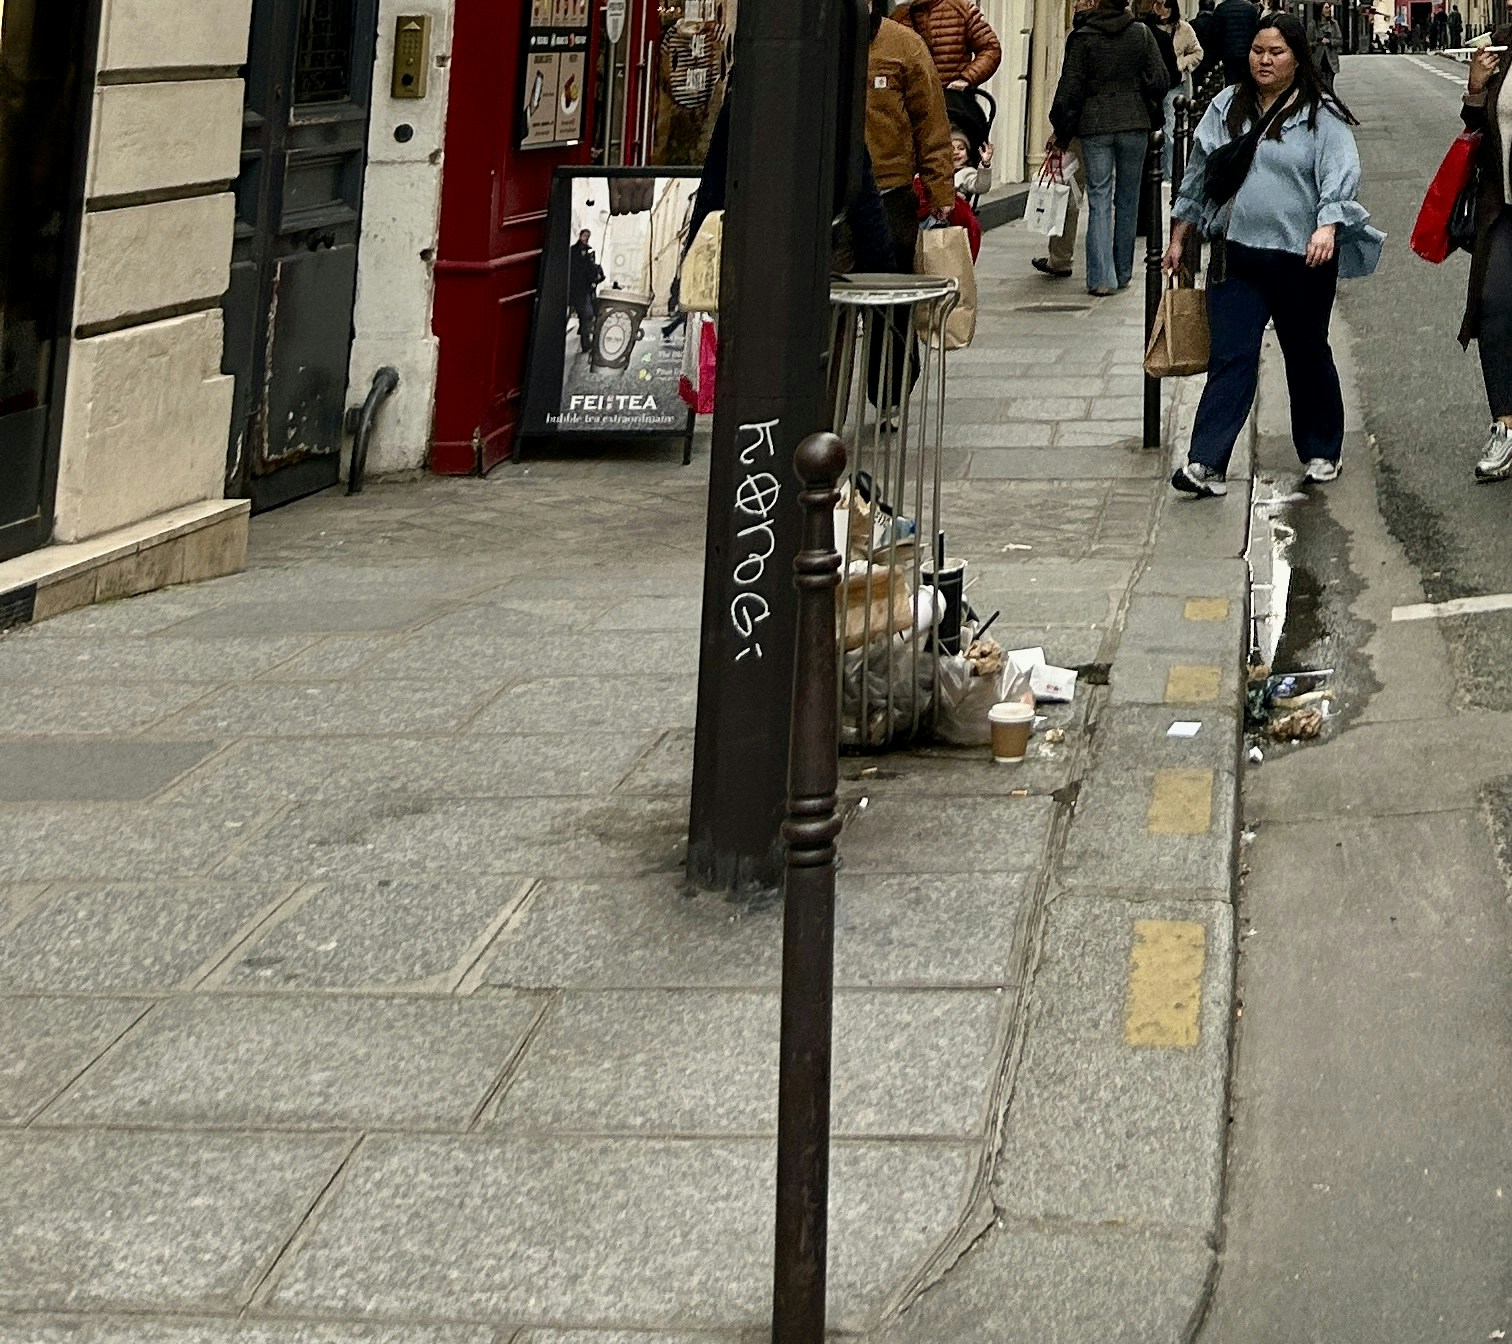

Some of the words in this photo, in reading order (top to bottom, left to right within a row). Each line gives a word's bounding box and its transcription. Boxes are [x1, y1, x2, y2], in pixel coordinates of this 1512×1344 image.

[569, 394, 605, 410] FEI
[614, 394, 658, 410] TEA
[545, 412, 582, 424] bubble
[584, 413, 600, 424] tea
